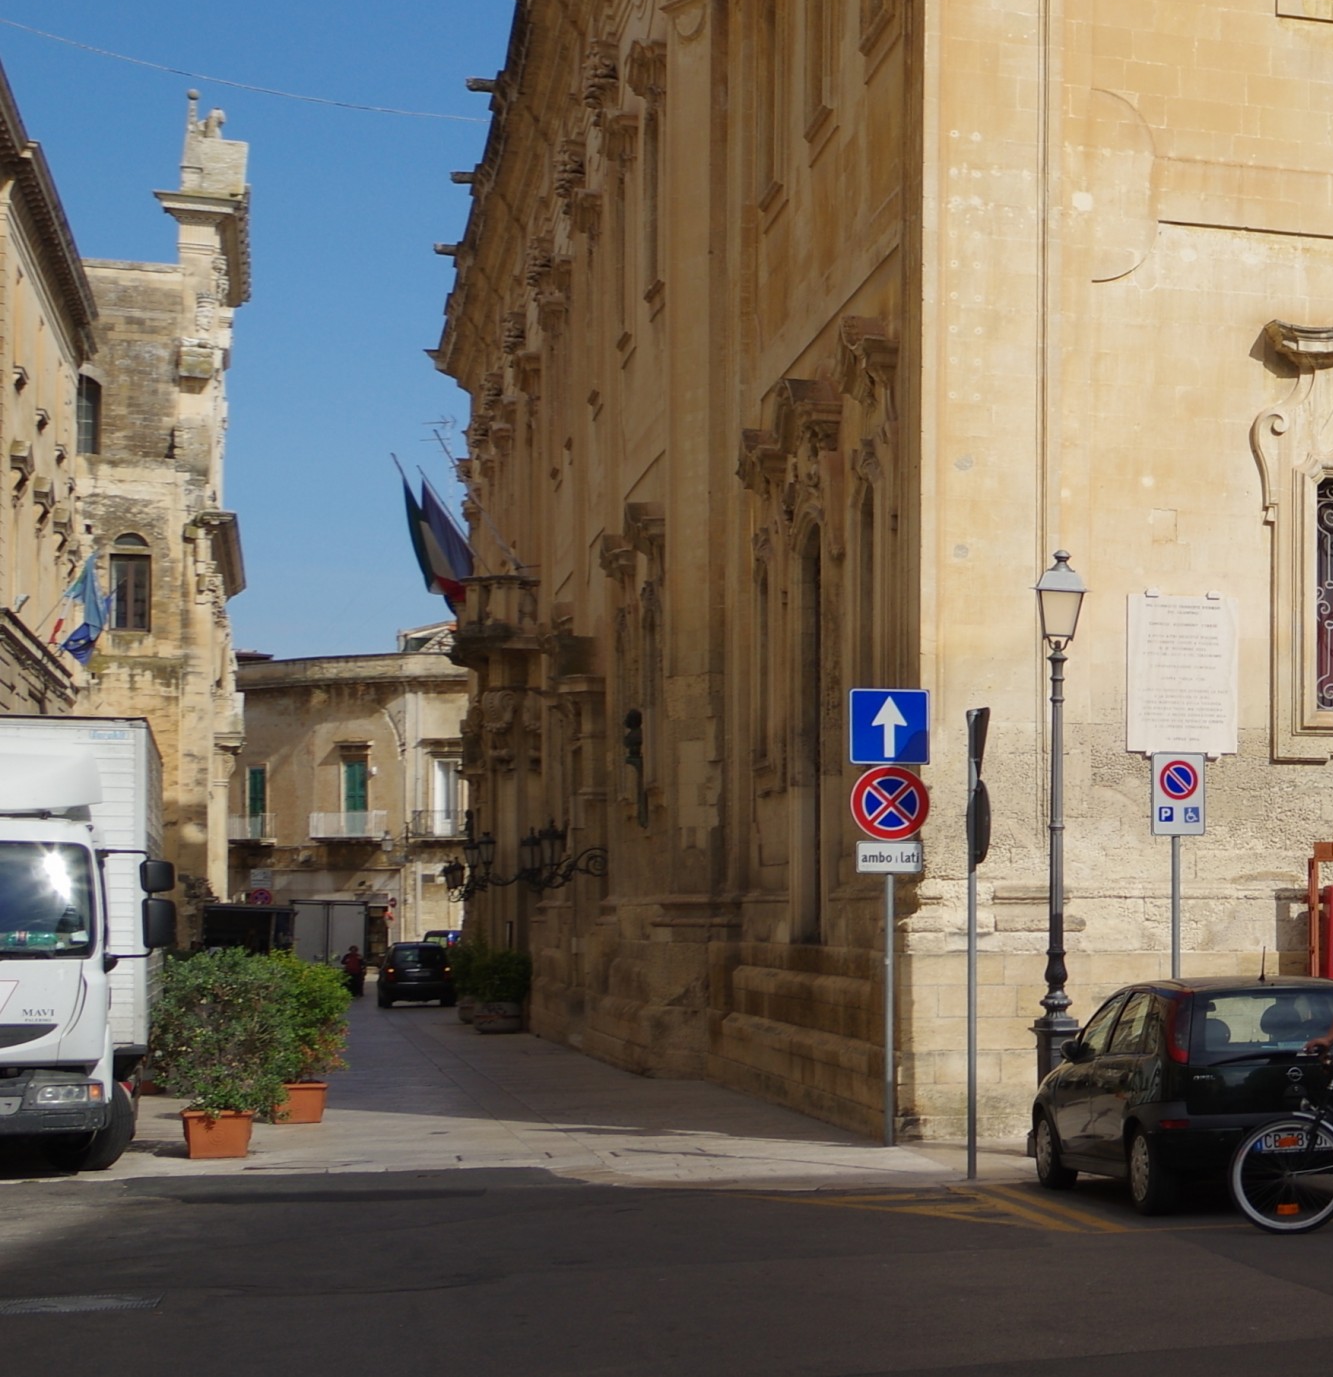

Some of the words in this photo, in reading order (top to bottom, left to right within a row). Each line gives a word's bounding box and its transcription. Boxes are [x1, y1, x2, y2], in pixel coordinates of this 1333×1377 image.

[861, 851, 893, 863] ambo
[900, 851, 920, 863] lati
[22, 1008, 55, 1017] MAVI
